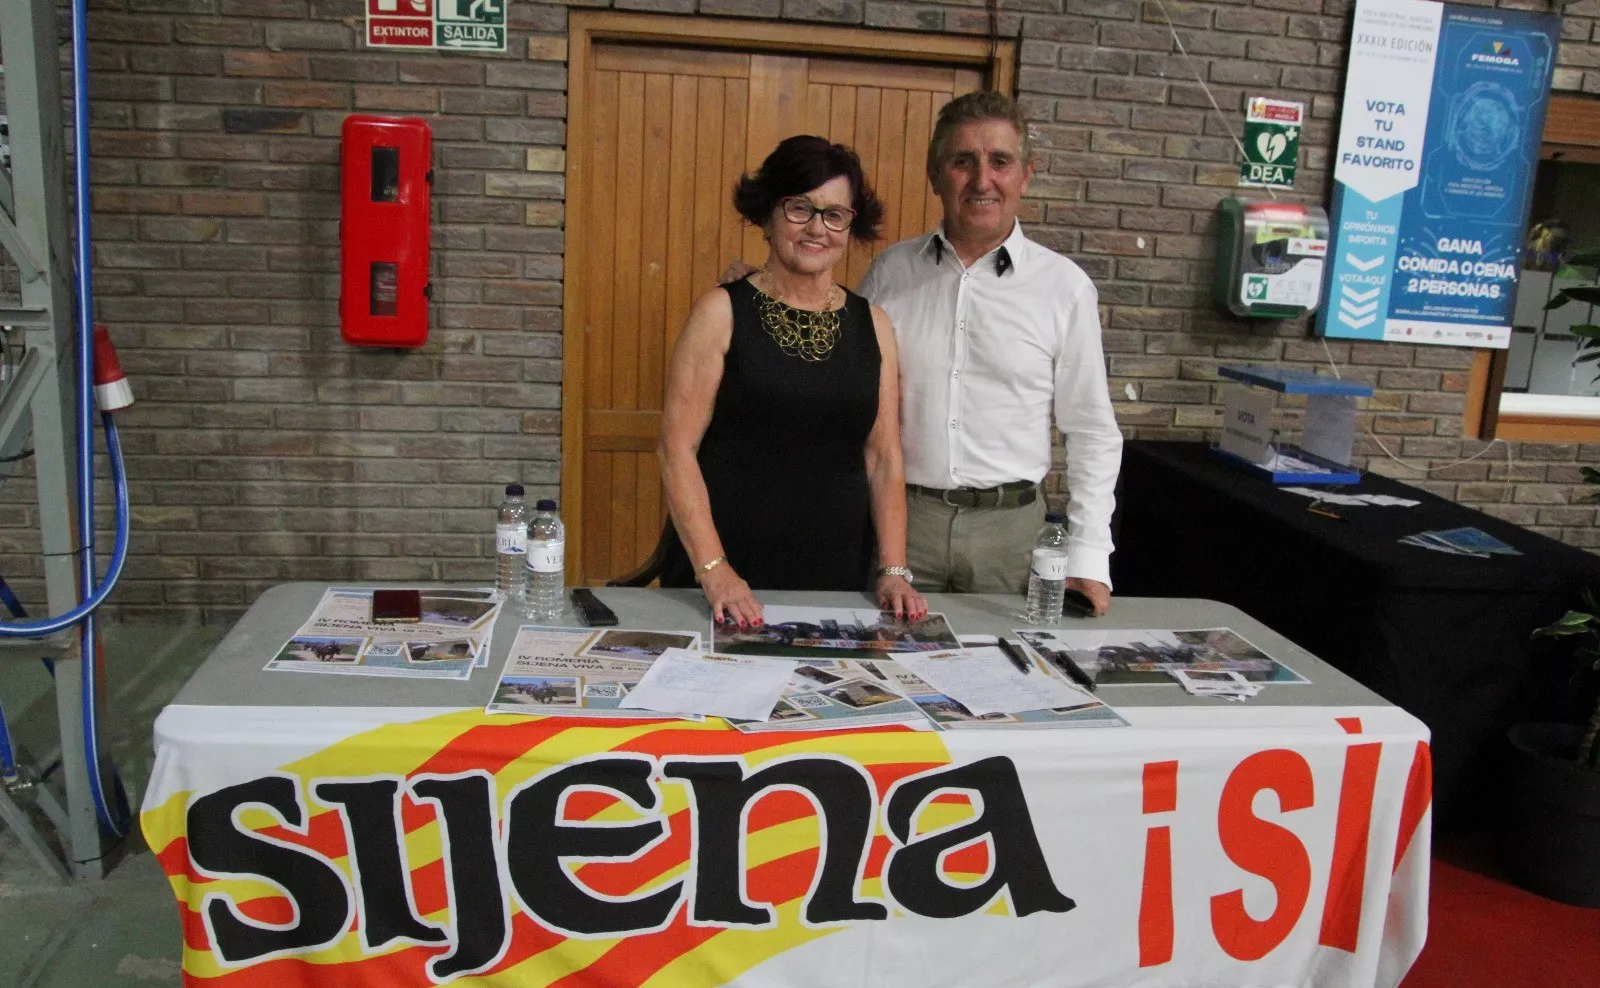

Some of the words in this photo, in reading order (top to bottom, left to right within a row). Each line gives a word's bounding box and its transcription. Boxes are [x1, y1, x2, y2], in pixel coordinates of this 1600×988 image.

[373, 26, 429, 38] EXTINTOR
[444, 26, 498, 40] SALIDA
[1357, 32, 1388, 48] XXXIX
[1391, 36, 1433, 53] EDICIÓN
[1471, 53, 1520, 66] FEMOGA
[1366, 100, 1405, 115] VOTA
[1374, 119, 1393, 132] TU
[1356, 135, 1405, 152] STAND
[1342, 152, 1415, 171] FAVORITO
[1250, 165, 1285, 182] DEA
[1366, 209, 1378, 220] TU
[1348, 235, 1388, 246] IMPORTA
[1437, 237, 1483, 255] GANA
[1398, 255, 1459, 275] COMIDA
[1460, 261, 1473, 276] O
[1473, 261, 1516, 279] CENA
[1340, 273, 1363, 284] VOTA
[1364, 274, 1387, 286] AQUÍ
[1407, 278, 1418, 293] 2
[1419, 279, 1501, 299] PERSONAS
